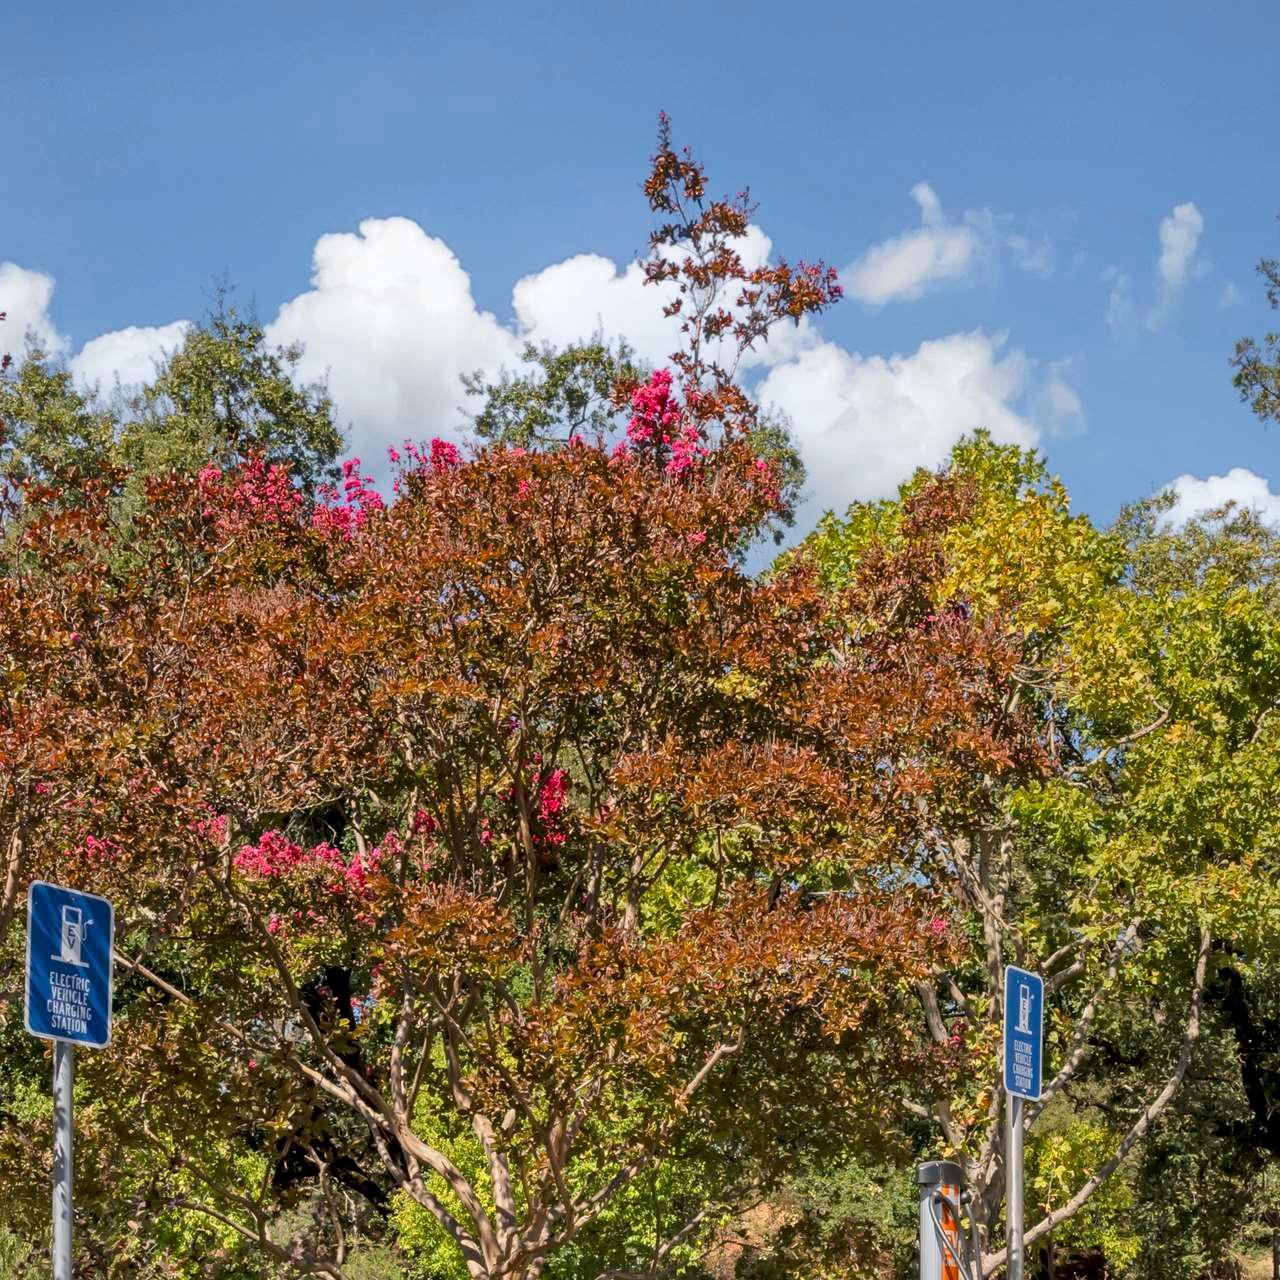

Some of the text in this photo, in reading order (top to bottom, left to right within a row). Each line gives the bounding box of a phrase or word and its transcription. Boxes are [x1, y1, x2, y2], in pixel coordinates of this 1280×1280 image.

[67, 925, 76, 949] EV
[49, 971, 91, 993] ELECTRIC
[51, 986, 89, 1006] VEHICLE
[46, 999, 92, 1021] CHARGING
[51, 1015, 87, 1034] STATION
